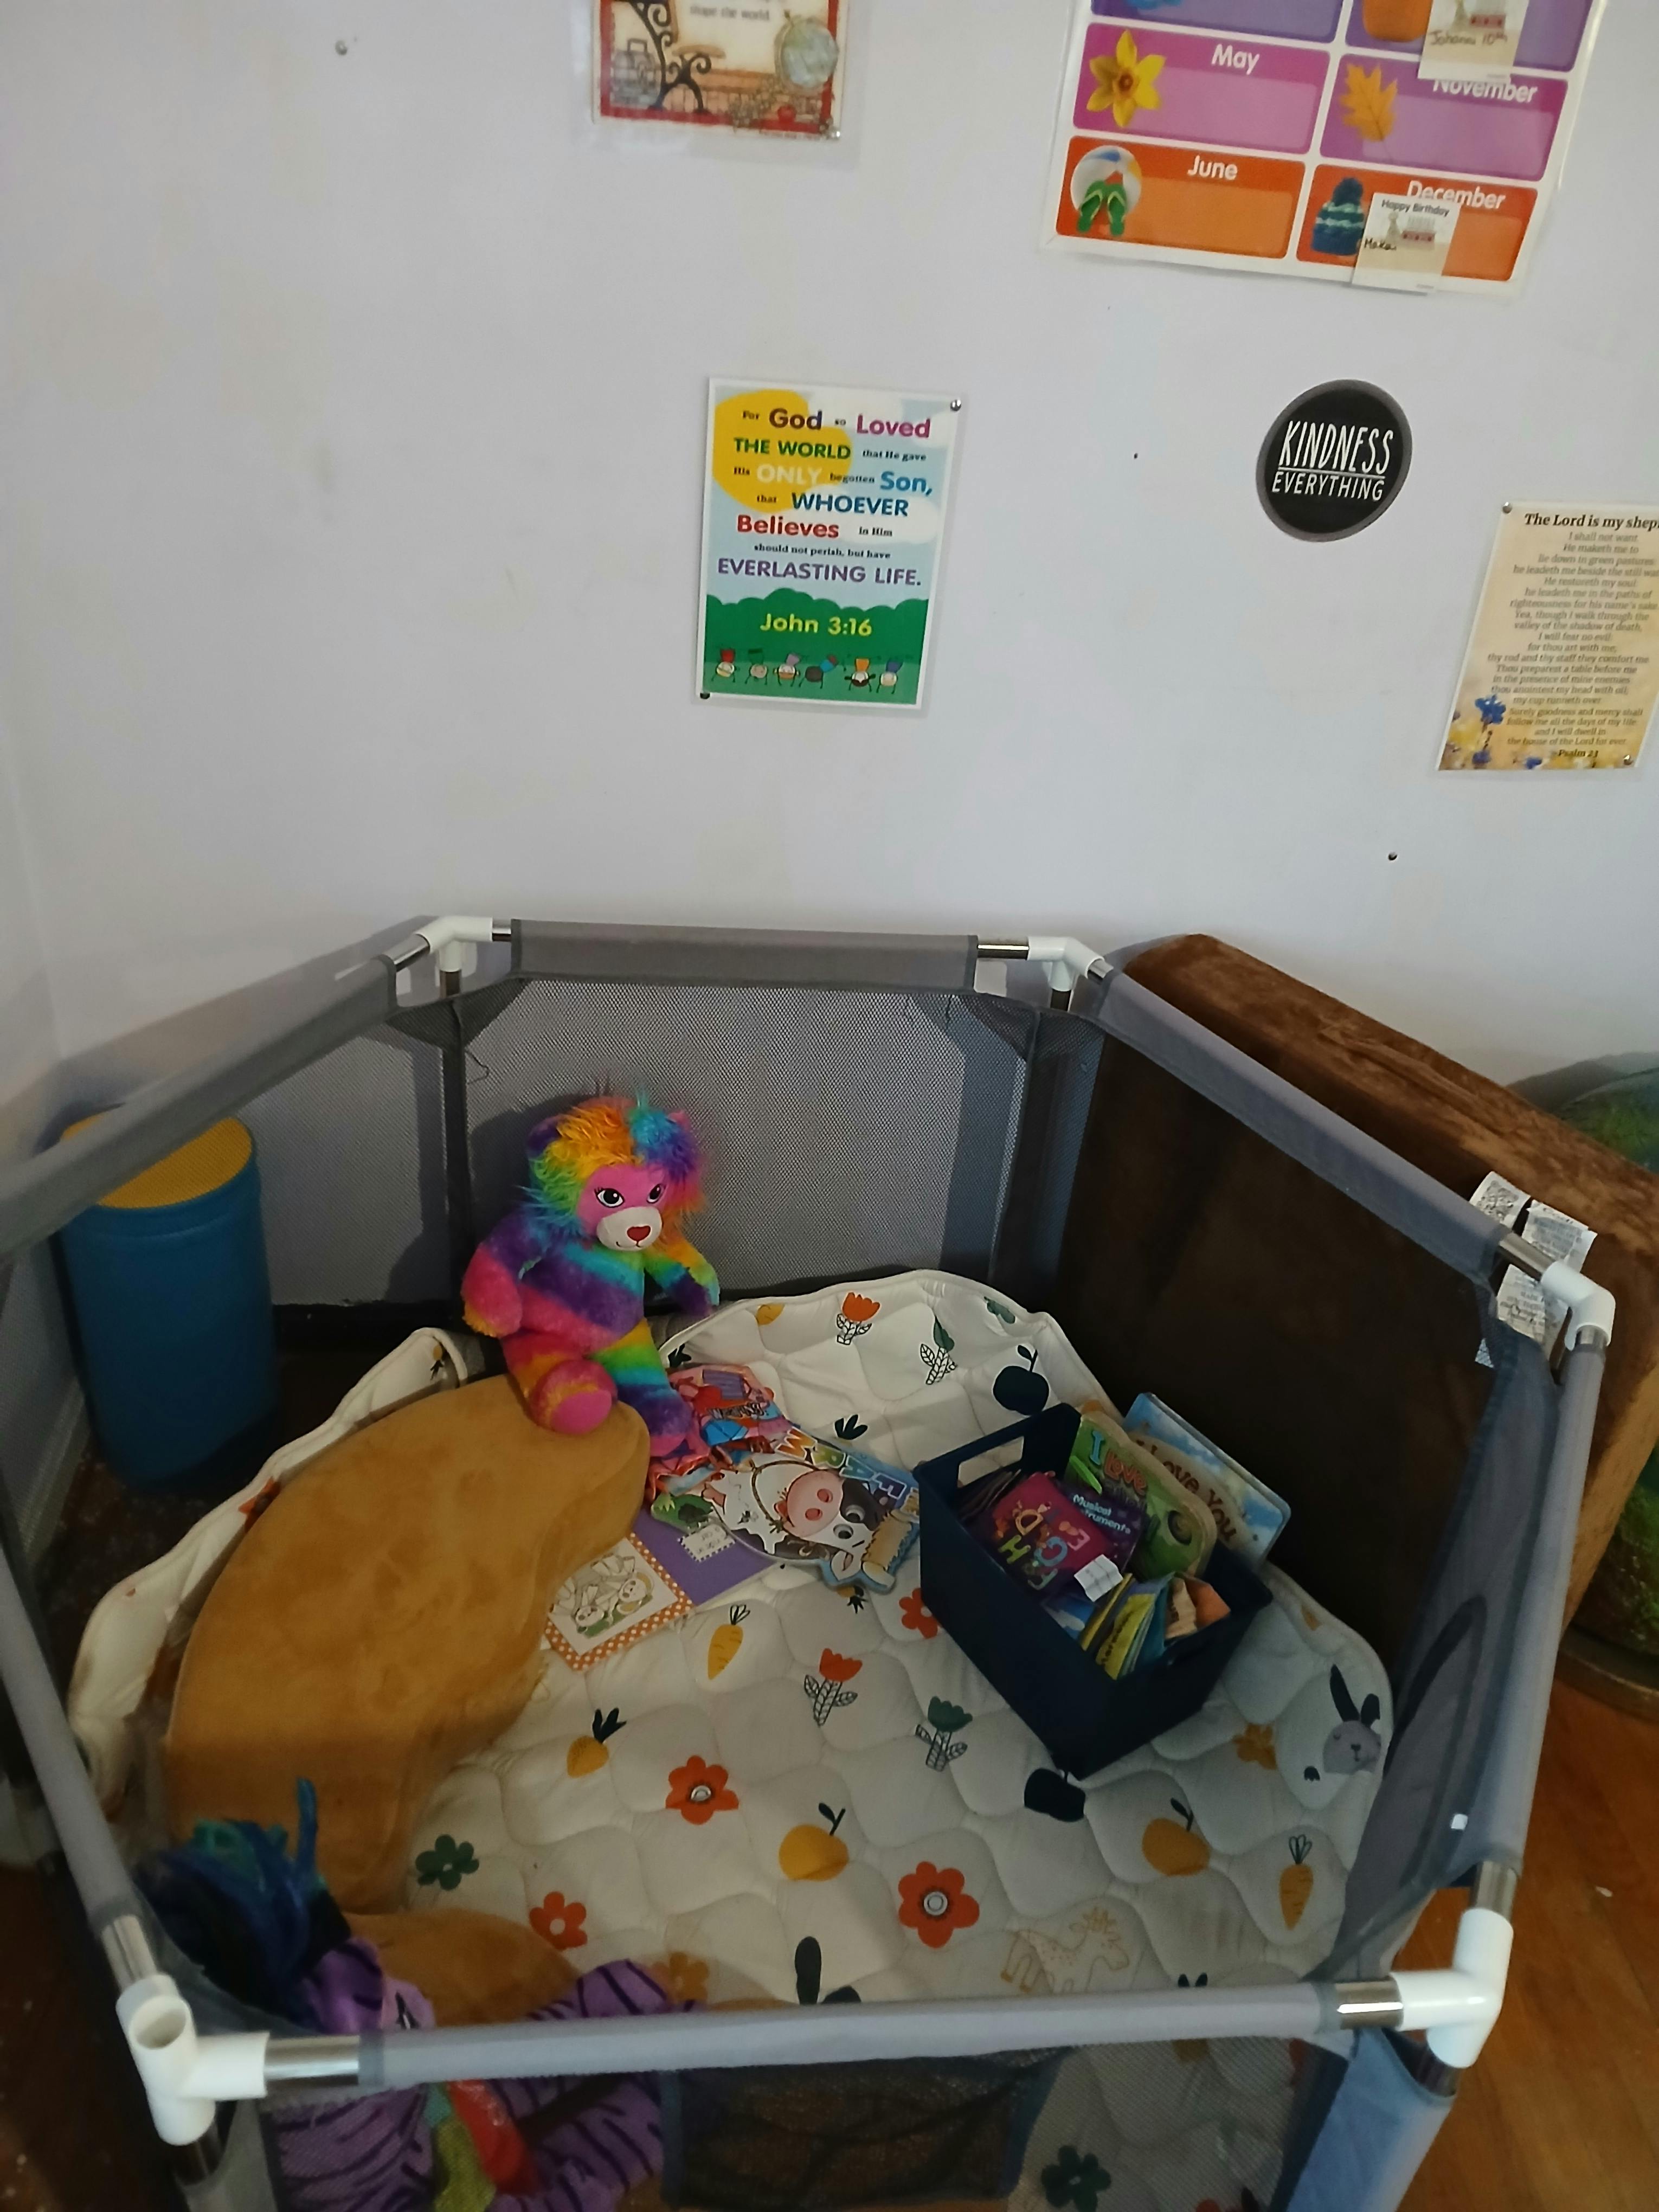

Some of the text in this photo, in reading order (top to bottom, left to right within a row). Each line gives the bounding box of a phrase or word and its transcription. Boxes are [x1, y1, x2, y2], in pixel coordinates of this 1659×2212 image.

[1211, 43, 1260, 74] May
[1433, 79, 1537, 105] November
[1187, 156, 1238, 182] June
[1381, 200, 1449, 217] Happy Birthday
[1407, 181, 1506, 211] December
[742, 408, 931, 438] For God so Loved
[734, 438, 926, 461] THE WORLD that He gave
[1279, 420, 1394, 474] KINDNESS
[734, 464, 933, 496] His ONLY begotten Son,
[1272, 472, 1385, 501] EVERYTHING
[756, 493, 908, 516] that WHOEVER
[737, 515, 839, 538] Believes
[872, 527, 892, 537] Him
[1525, 513, 1549, 526] The
[1553, 513, 1585, 526] Lord
[1587, 515, 1599, 527] is
[1602, 518, 1623, 530] my
[754, 544, 891, 559] should not perish, but have
[718, 558, 921, 586] EVERLASTING LIFE.
[760, 613, 872, 636] John 3:16
[1558, 749, 1586, 757] Psalm
[774, 1425, 908, 1500] FARM
[1089, 1430, 1147, 1496] I Love
[1072, 1493, 1111, 1517] Musical
[1150, 1445, 1200, 1494] ove
[1208, 1489, 1237, 1542] You
